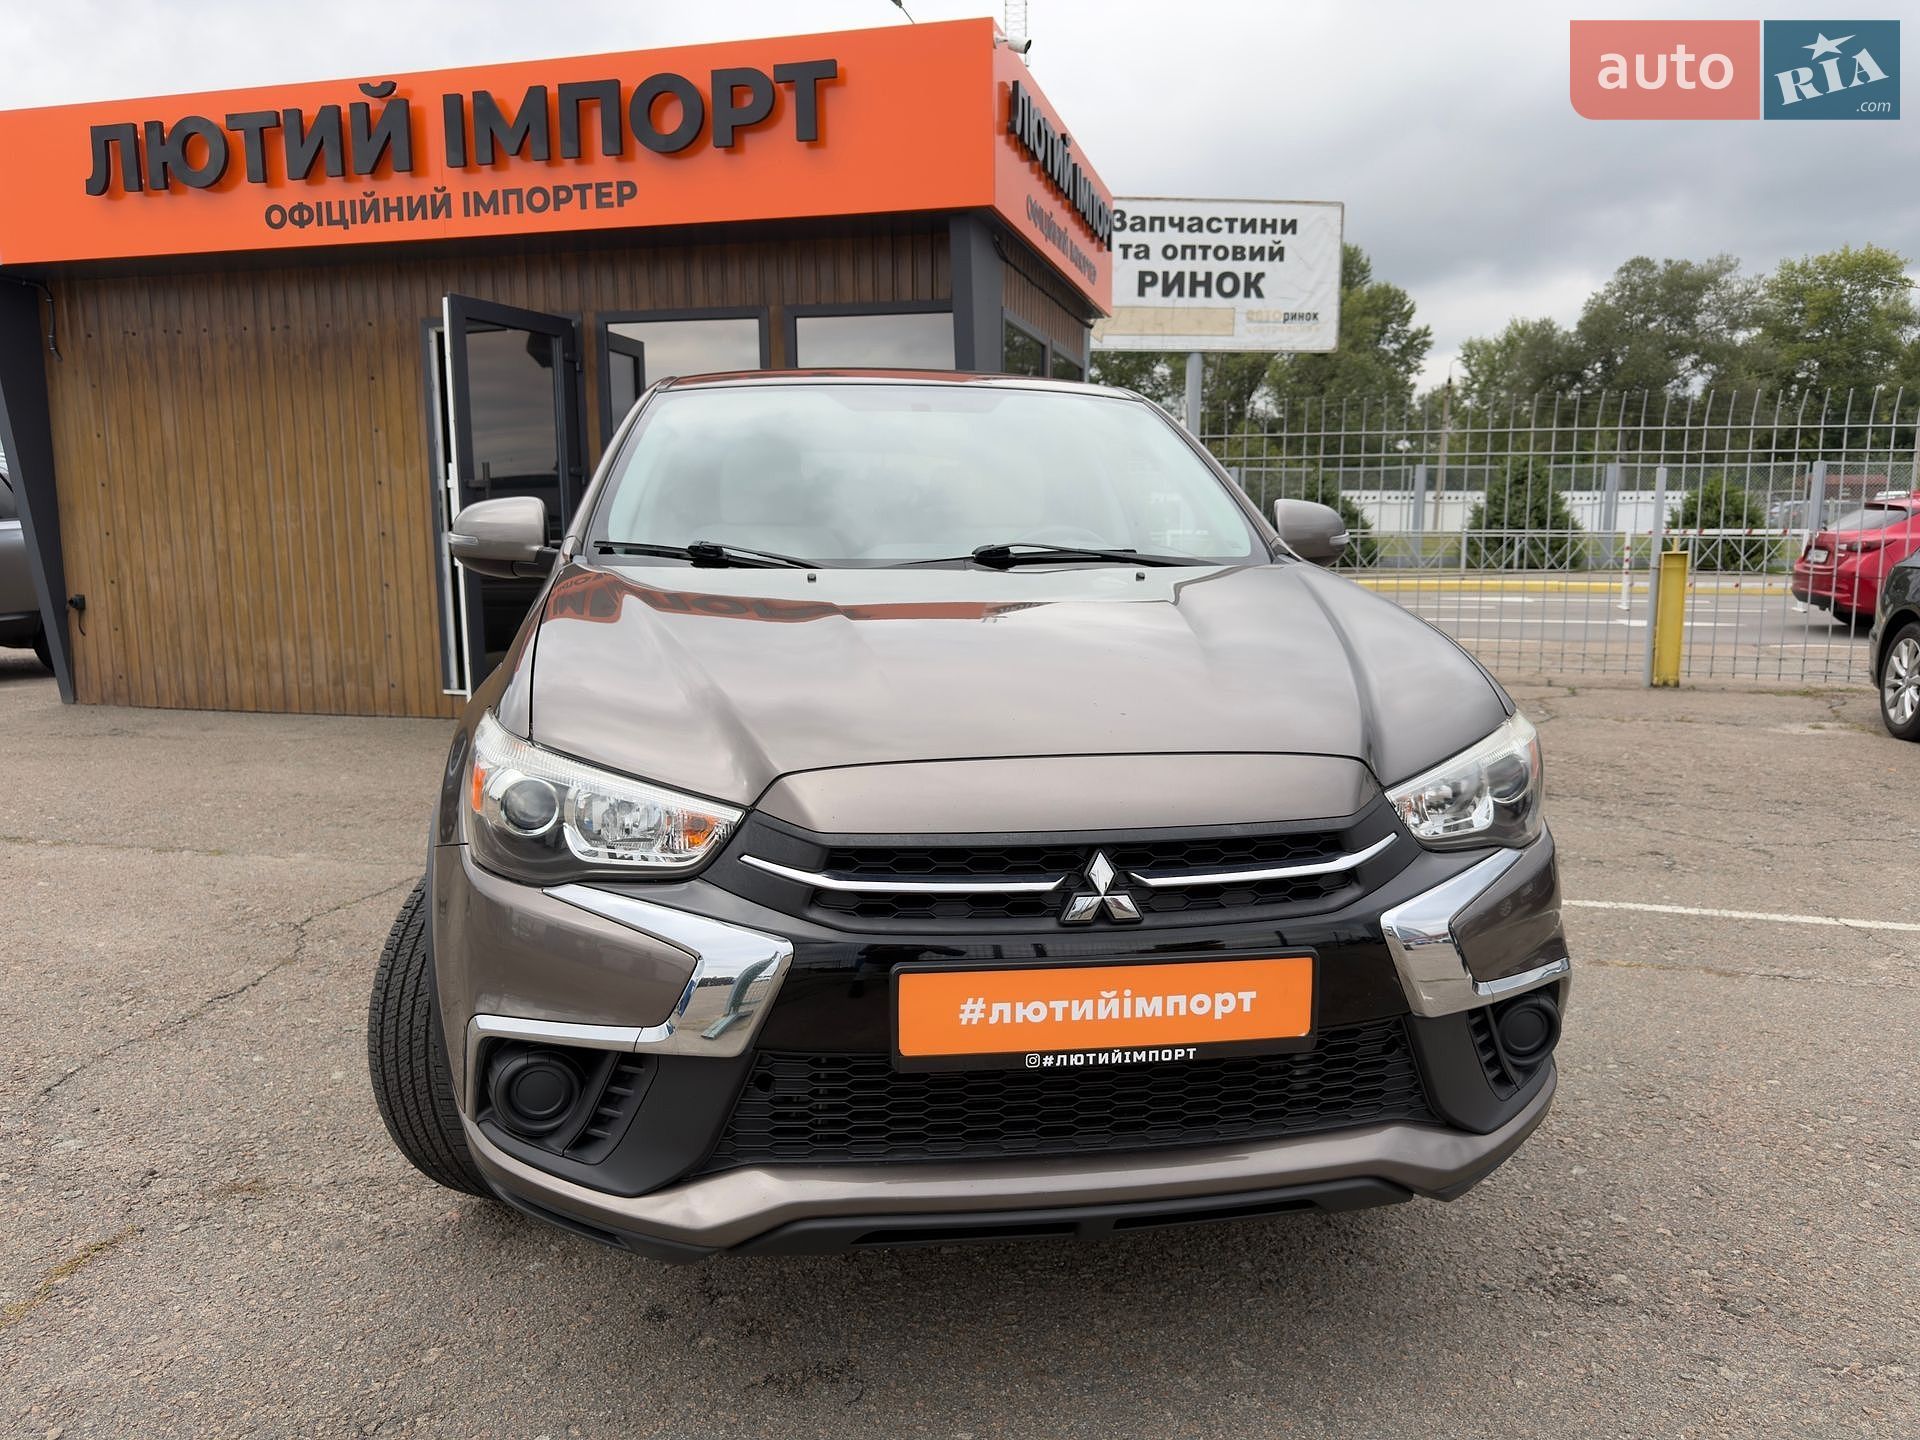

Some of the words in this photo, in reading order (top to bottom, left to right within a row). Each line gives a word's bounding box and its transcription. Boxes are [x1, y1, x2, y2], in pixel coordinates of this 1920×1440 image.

[85, 80, 413, 196] ЛЮТИЙ
[442, 58, 838, 168] ІМПОРТ
[1008, 79, 1073, 200] ЛЮТИЙ
[264, 186, 454, 231] ОФІЦІЙНИЙ
[463, 180, 638, 218] ІМПОРТЕР
[1112, 209, 1298, 235] Запчастини
[1119, 243, 1150, 260] та
[1161, 240, 1285, 262] оптовий
[1137, 270, 1266, 299] РИНОК
[959, 989, 1257, 1025] #лютийімпорт
[1043, 1048, 1197, 1067] #ЛЮТИЙІМПОРТ
